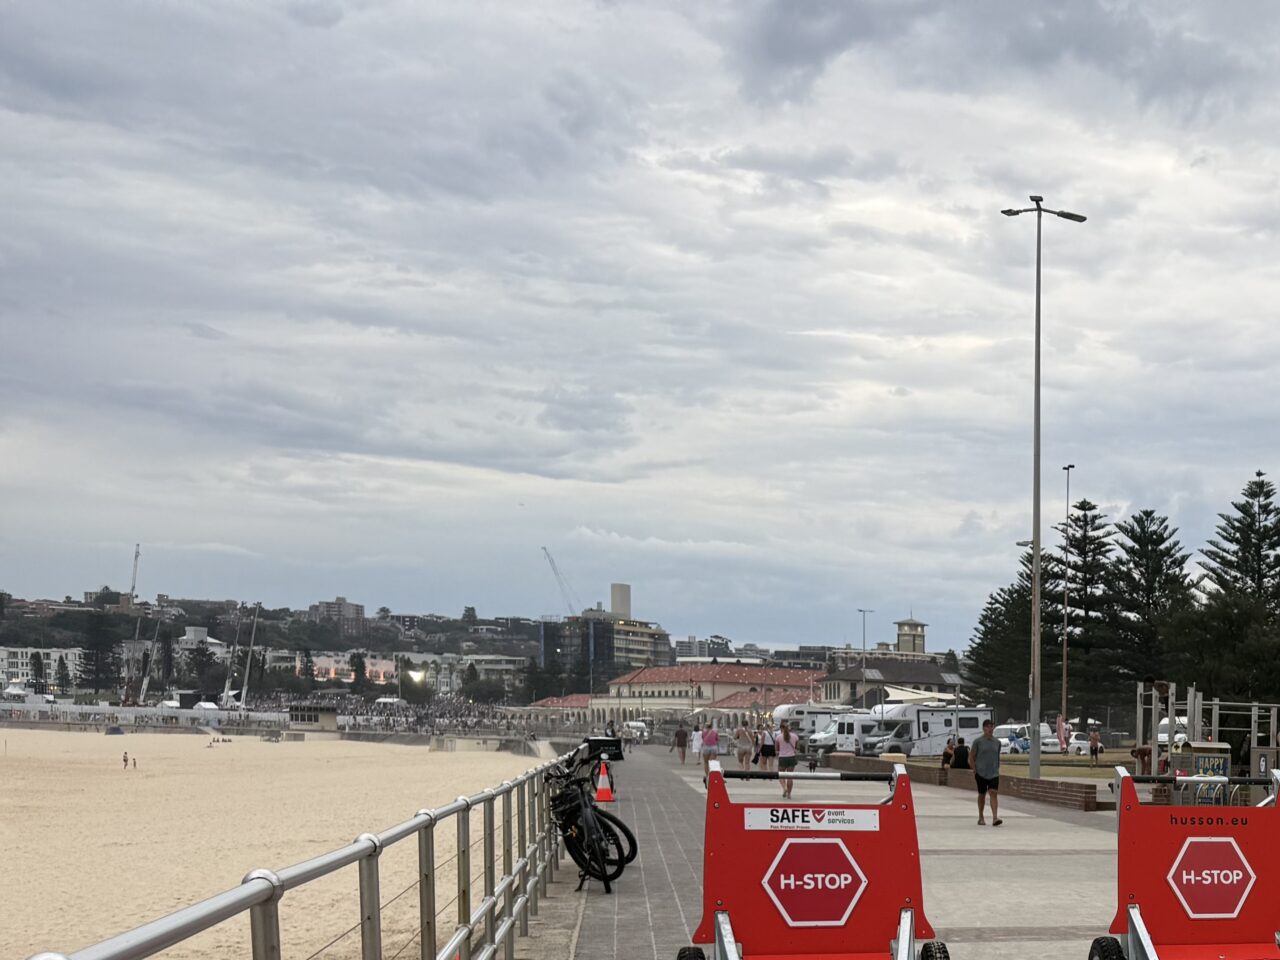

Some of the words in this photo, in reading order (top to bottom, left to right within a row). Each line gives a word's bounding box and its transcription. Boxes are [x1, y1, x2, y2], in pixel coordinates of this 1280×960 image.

[1199, 757, 1224, 769] HAPPY
[770, 809, 811, 824] SAFE
[1170, 814, 1248, 826] husson.eu
[780, 873, 853, 890] H-STOP
[1182, 869, 1244, 885] H-STOP
